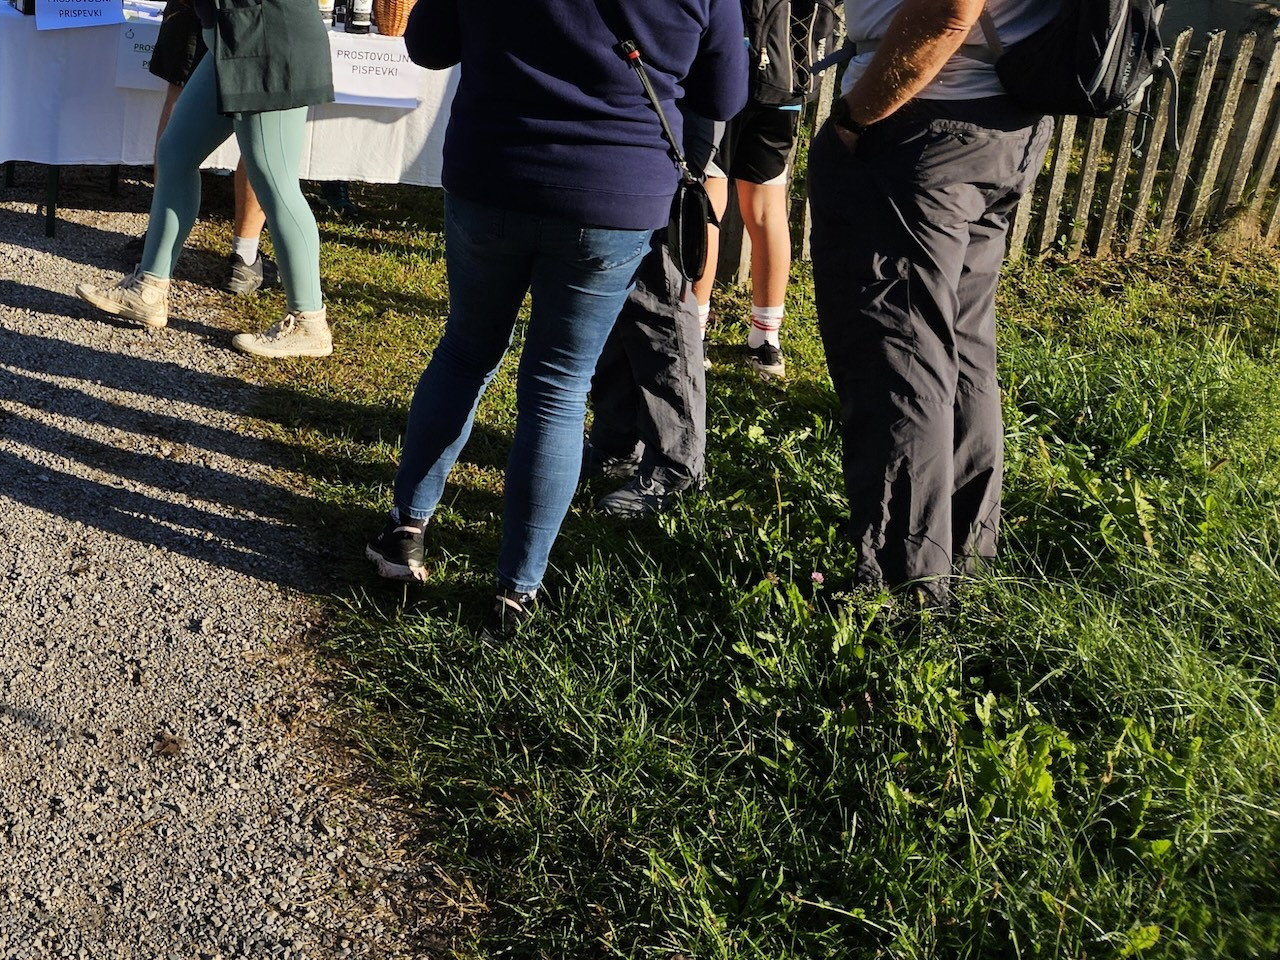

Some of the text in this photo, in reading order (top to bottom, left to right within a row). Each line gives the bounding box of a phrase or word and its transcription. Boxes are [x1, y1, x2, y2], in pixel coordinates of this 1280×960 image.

[59, 9, 102, 18] PRISPEVKI
[336, 49, 413, 63] PROSTOVOLJN
[352, 65, 398, 77] PISPEVKI
